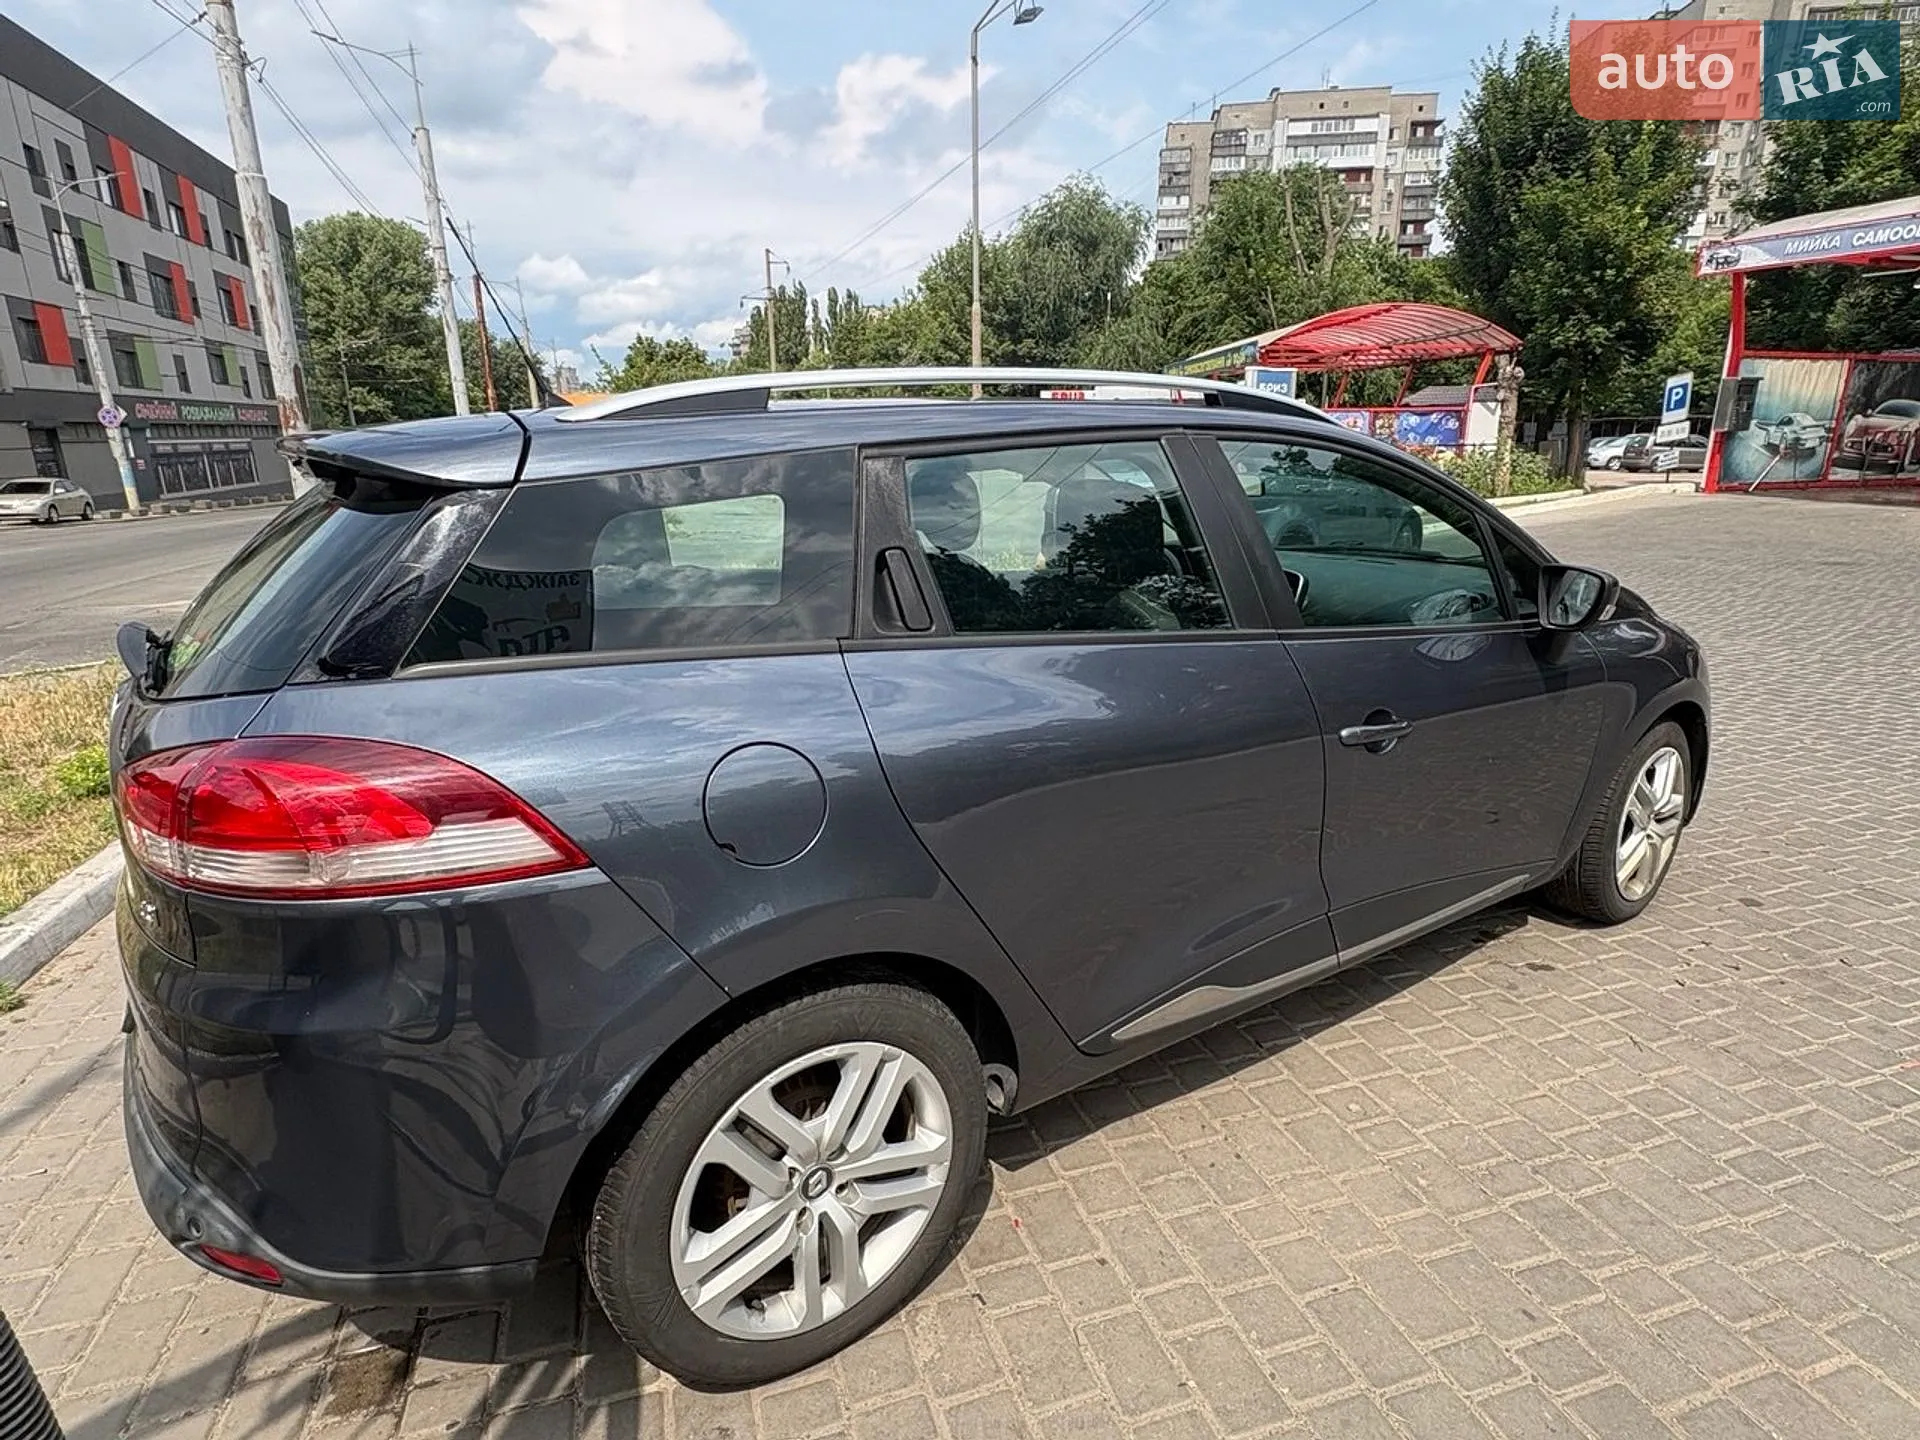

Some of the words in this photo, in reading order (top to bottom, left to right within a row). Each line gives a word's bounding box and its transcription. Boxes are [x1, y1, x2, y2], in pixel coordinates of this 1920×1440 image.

[1783, 235, 1841, 255] МИЙКА
[1851, 224, 1920, 247] САМОО
[1670, 387, 1683, 409] P
